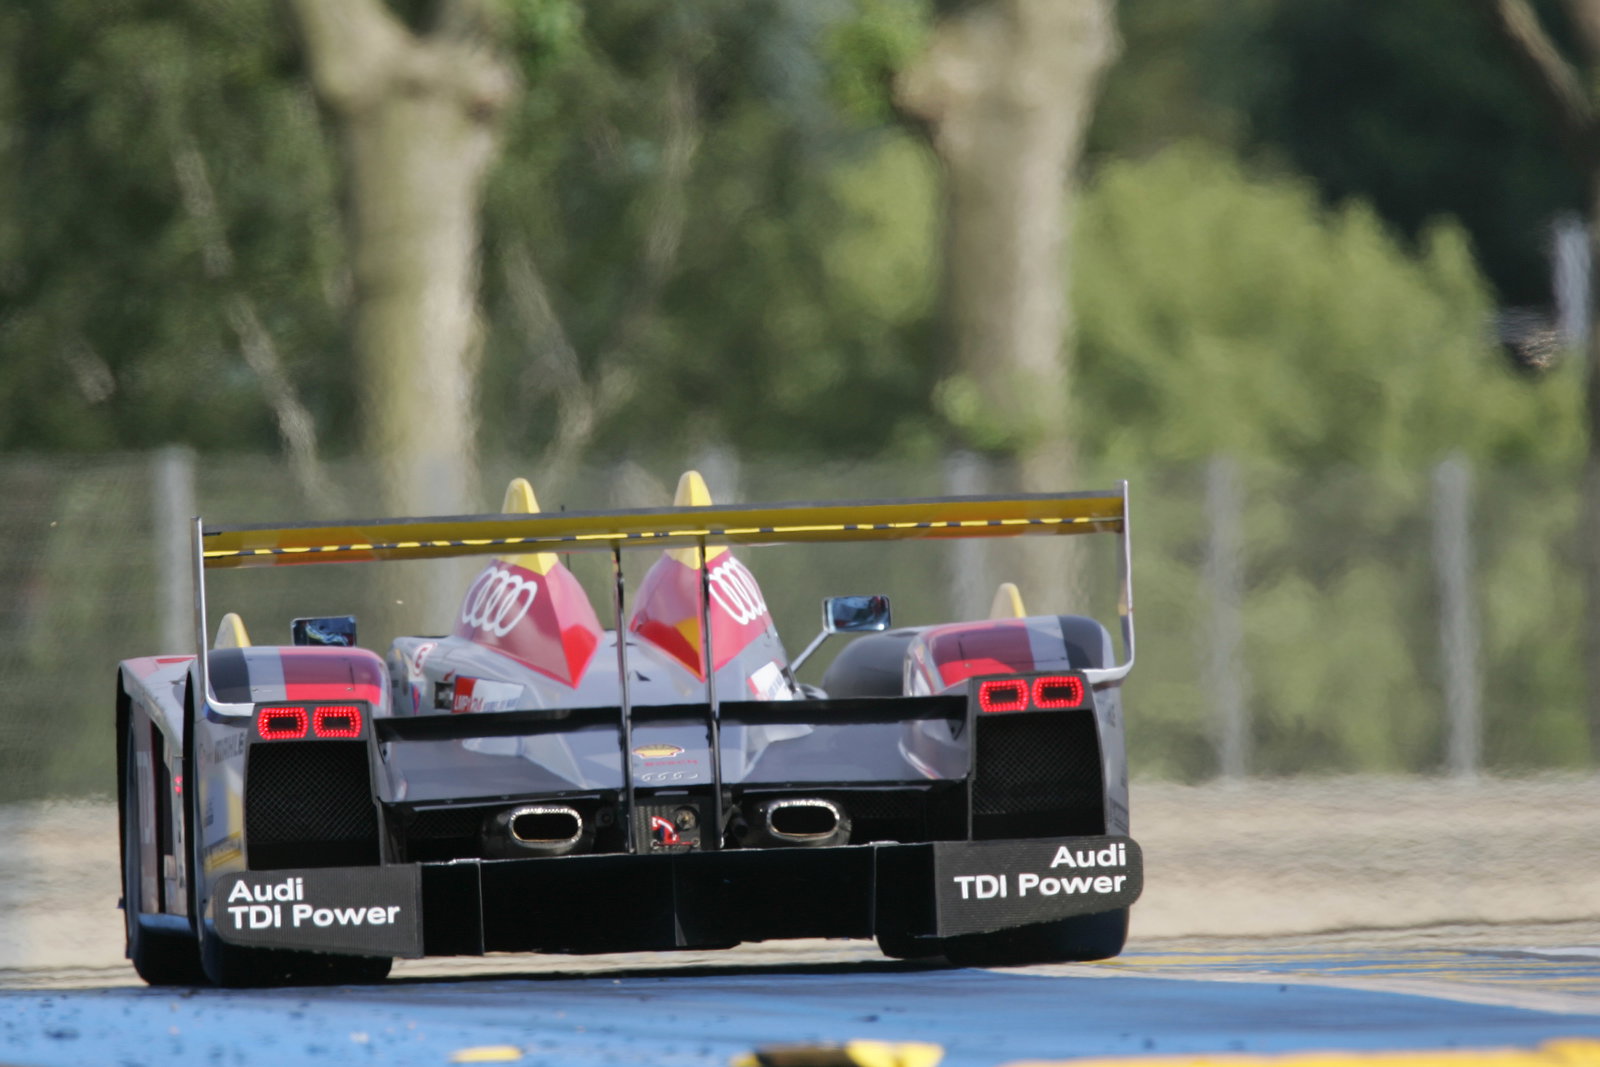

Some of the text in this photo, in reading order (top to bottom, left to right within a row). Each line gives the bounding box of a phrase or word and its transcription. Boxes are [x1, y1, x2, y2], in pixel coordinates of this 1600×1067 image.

[1050, 843, 1127, 868] Audi
[227, 877, 304, 903] Audi
[953, 873, 1127, 899] TDI Power
[227, 903, 401, 929] TDI Power
